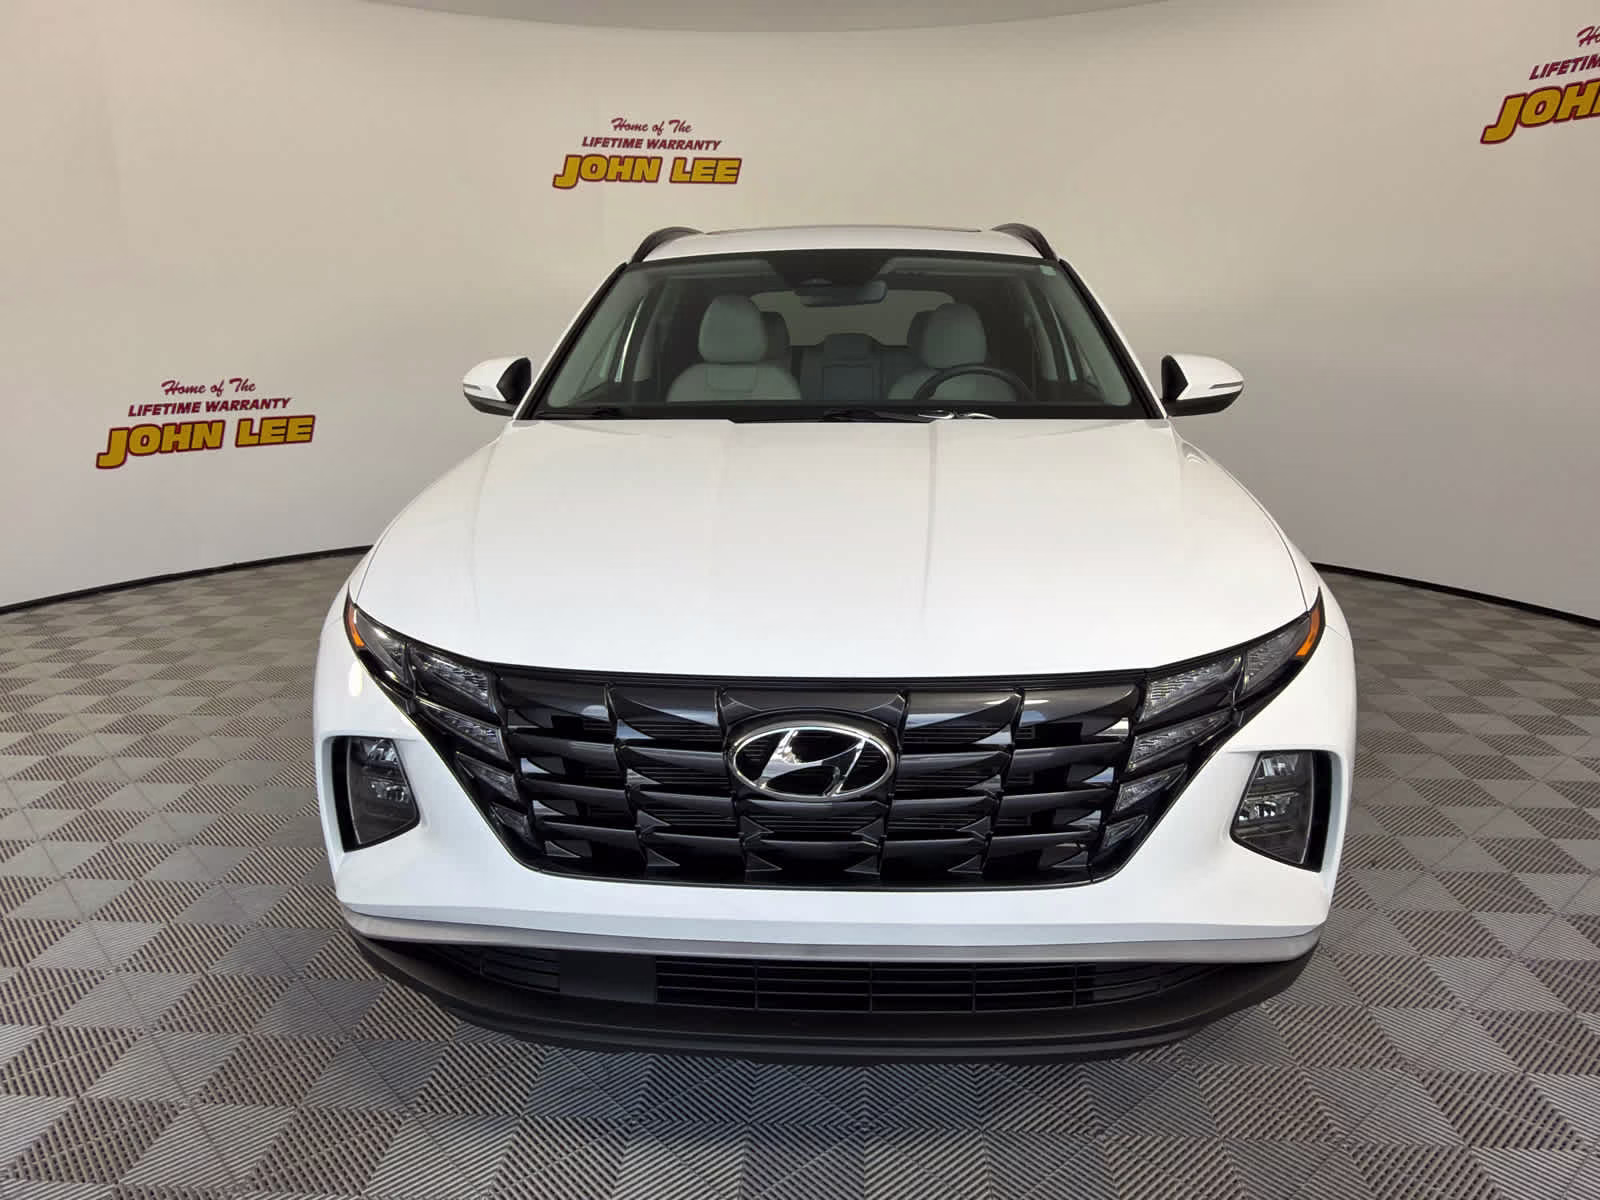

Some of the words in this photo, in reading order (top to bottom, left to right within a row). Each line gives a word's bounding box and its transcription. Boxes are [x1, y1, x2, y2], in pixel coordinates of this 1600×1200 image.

[1480, 78, 1600, 144] JOH
[611, 117, 648, 132] Home
[652, 120, 664, 136] of
[668, 119, 692, 133] The
[581, 136, 644, 149] LIFETIME
[646, 139, 722, 151] WARRANTY
[552, 153, 663, 190] JOHN
[669, 157, 742, 184] LEE
[161, 379, 206, 396] Home
[210, 379, 224, 397] of
[229, 377, 256, 393] The
[128, 401, 202, 417] LIFETIME
[205, 397, 292, 413] WARRANTY
[96, 419, 226, 470] JOHN
[234, 414, 316, 448] LEE
